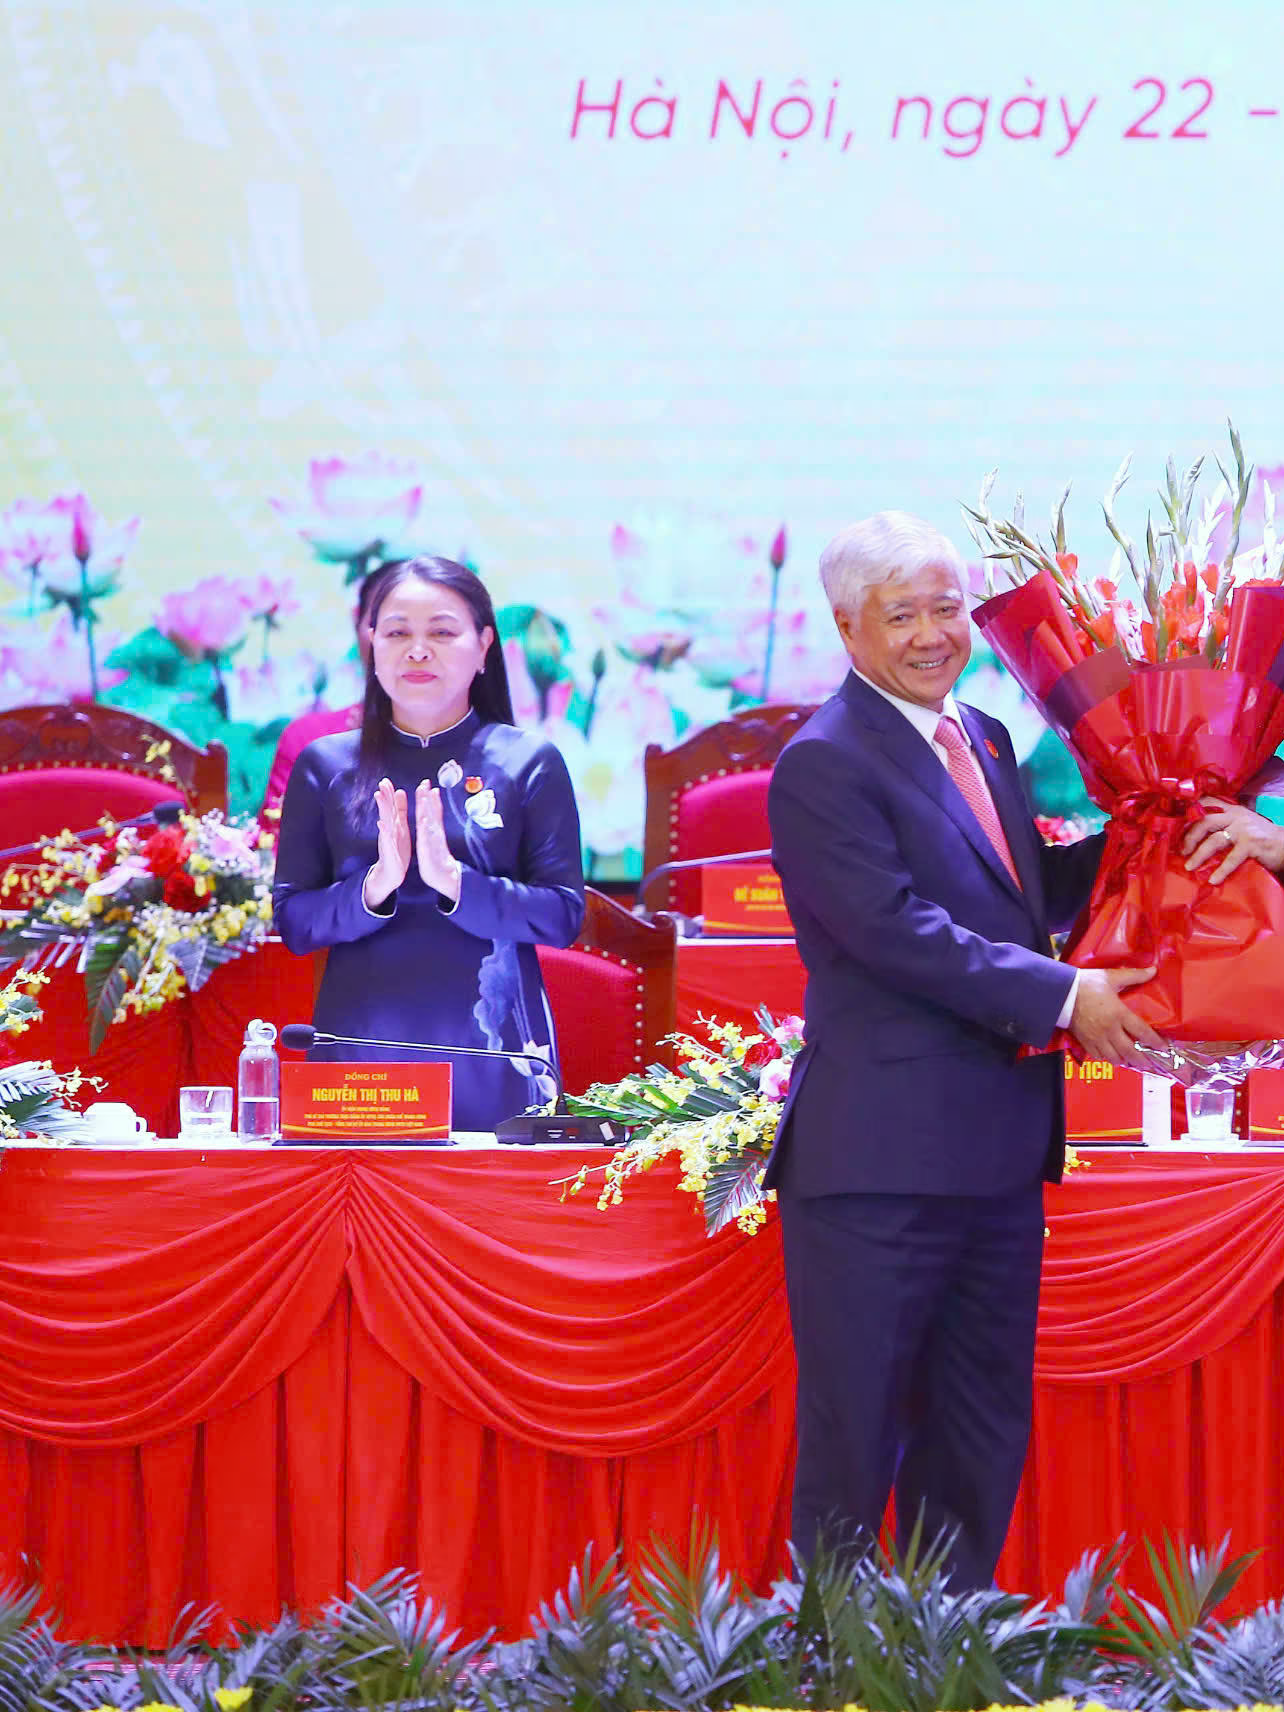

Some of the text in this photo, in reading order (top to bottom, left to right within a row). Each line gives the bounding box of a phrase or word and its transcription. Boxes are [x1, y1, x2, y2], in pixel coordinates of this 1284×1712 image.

[571, 78, 677, 140] Hà
[711, 79, 853, 158] Nội,
[892, 76, 1096, 156] ngày
[1124, 77, 1215, 140] 22
[311, 1083, 420, 1105] NGUYỄN THỊ THU HÀ
